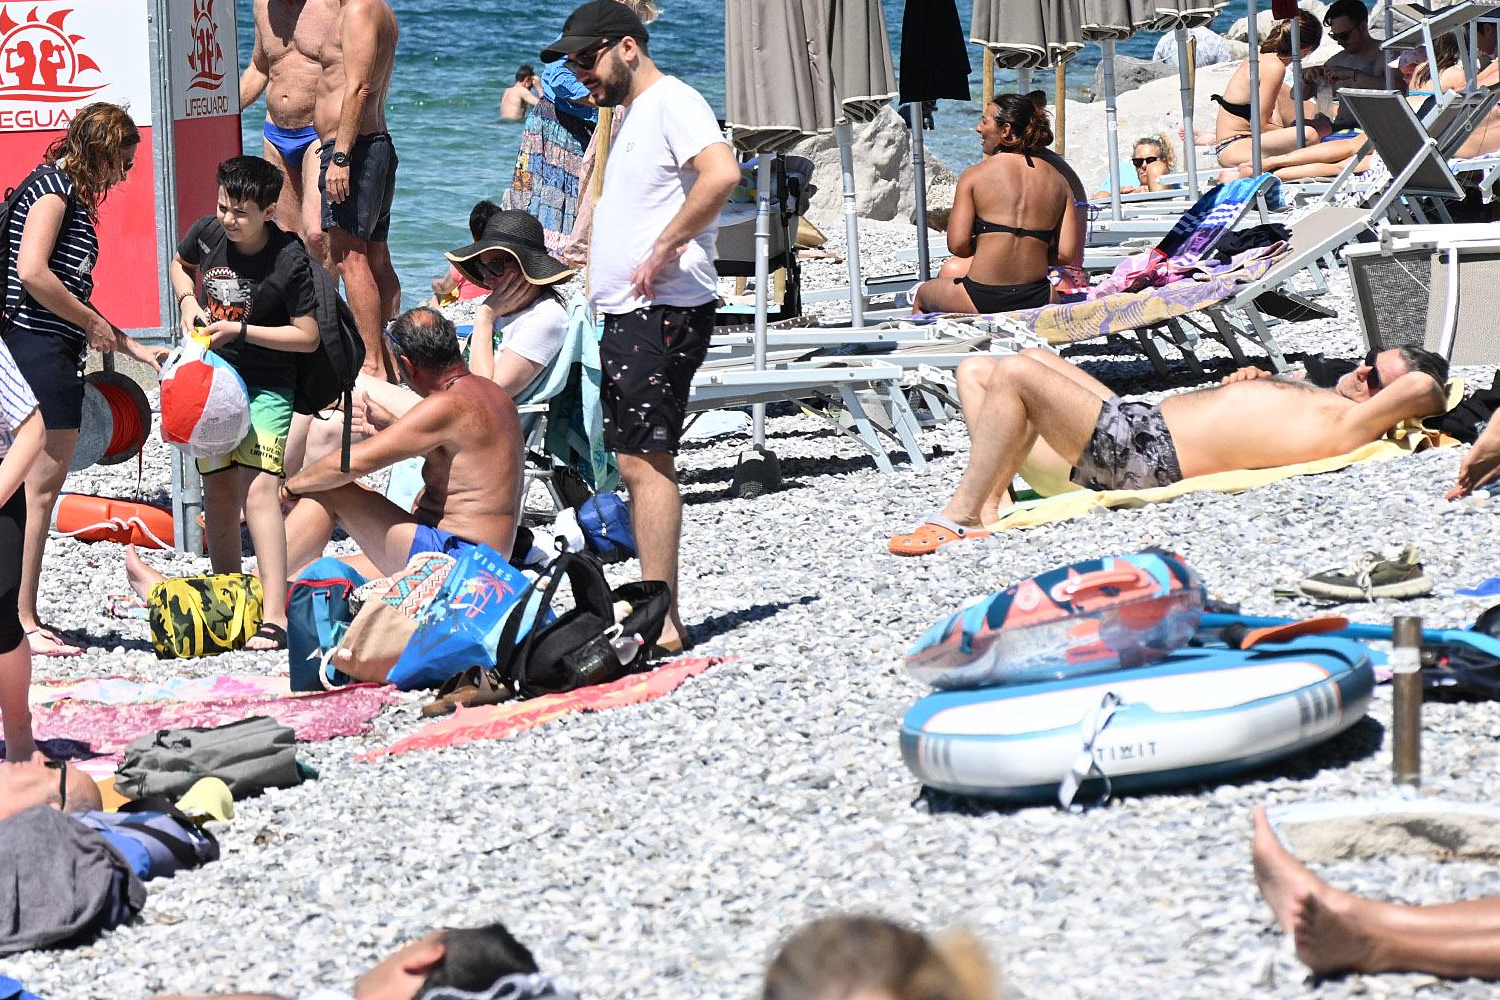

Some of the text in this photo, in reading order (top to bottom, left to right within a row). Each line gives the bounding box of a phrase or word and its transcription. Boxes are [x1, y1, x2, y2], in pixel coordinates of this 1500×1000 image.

[185, 96, 228, 116] LIFEGUARD
[473, 551, 513, 582] VIBES
[1097, 742, 1156, 760] TIWIT
